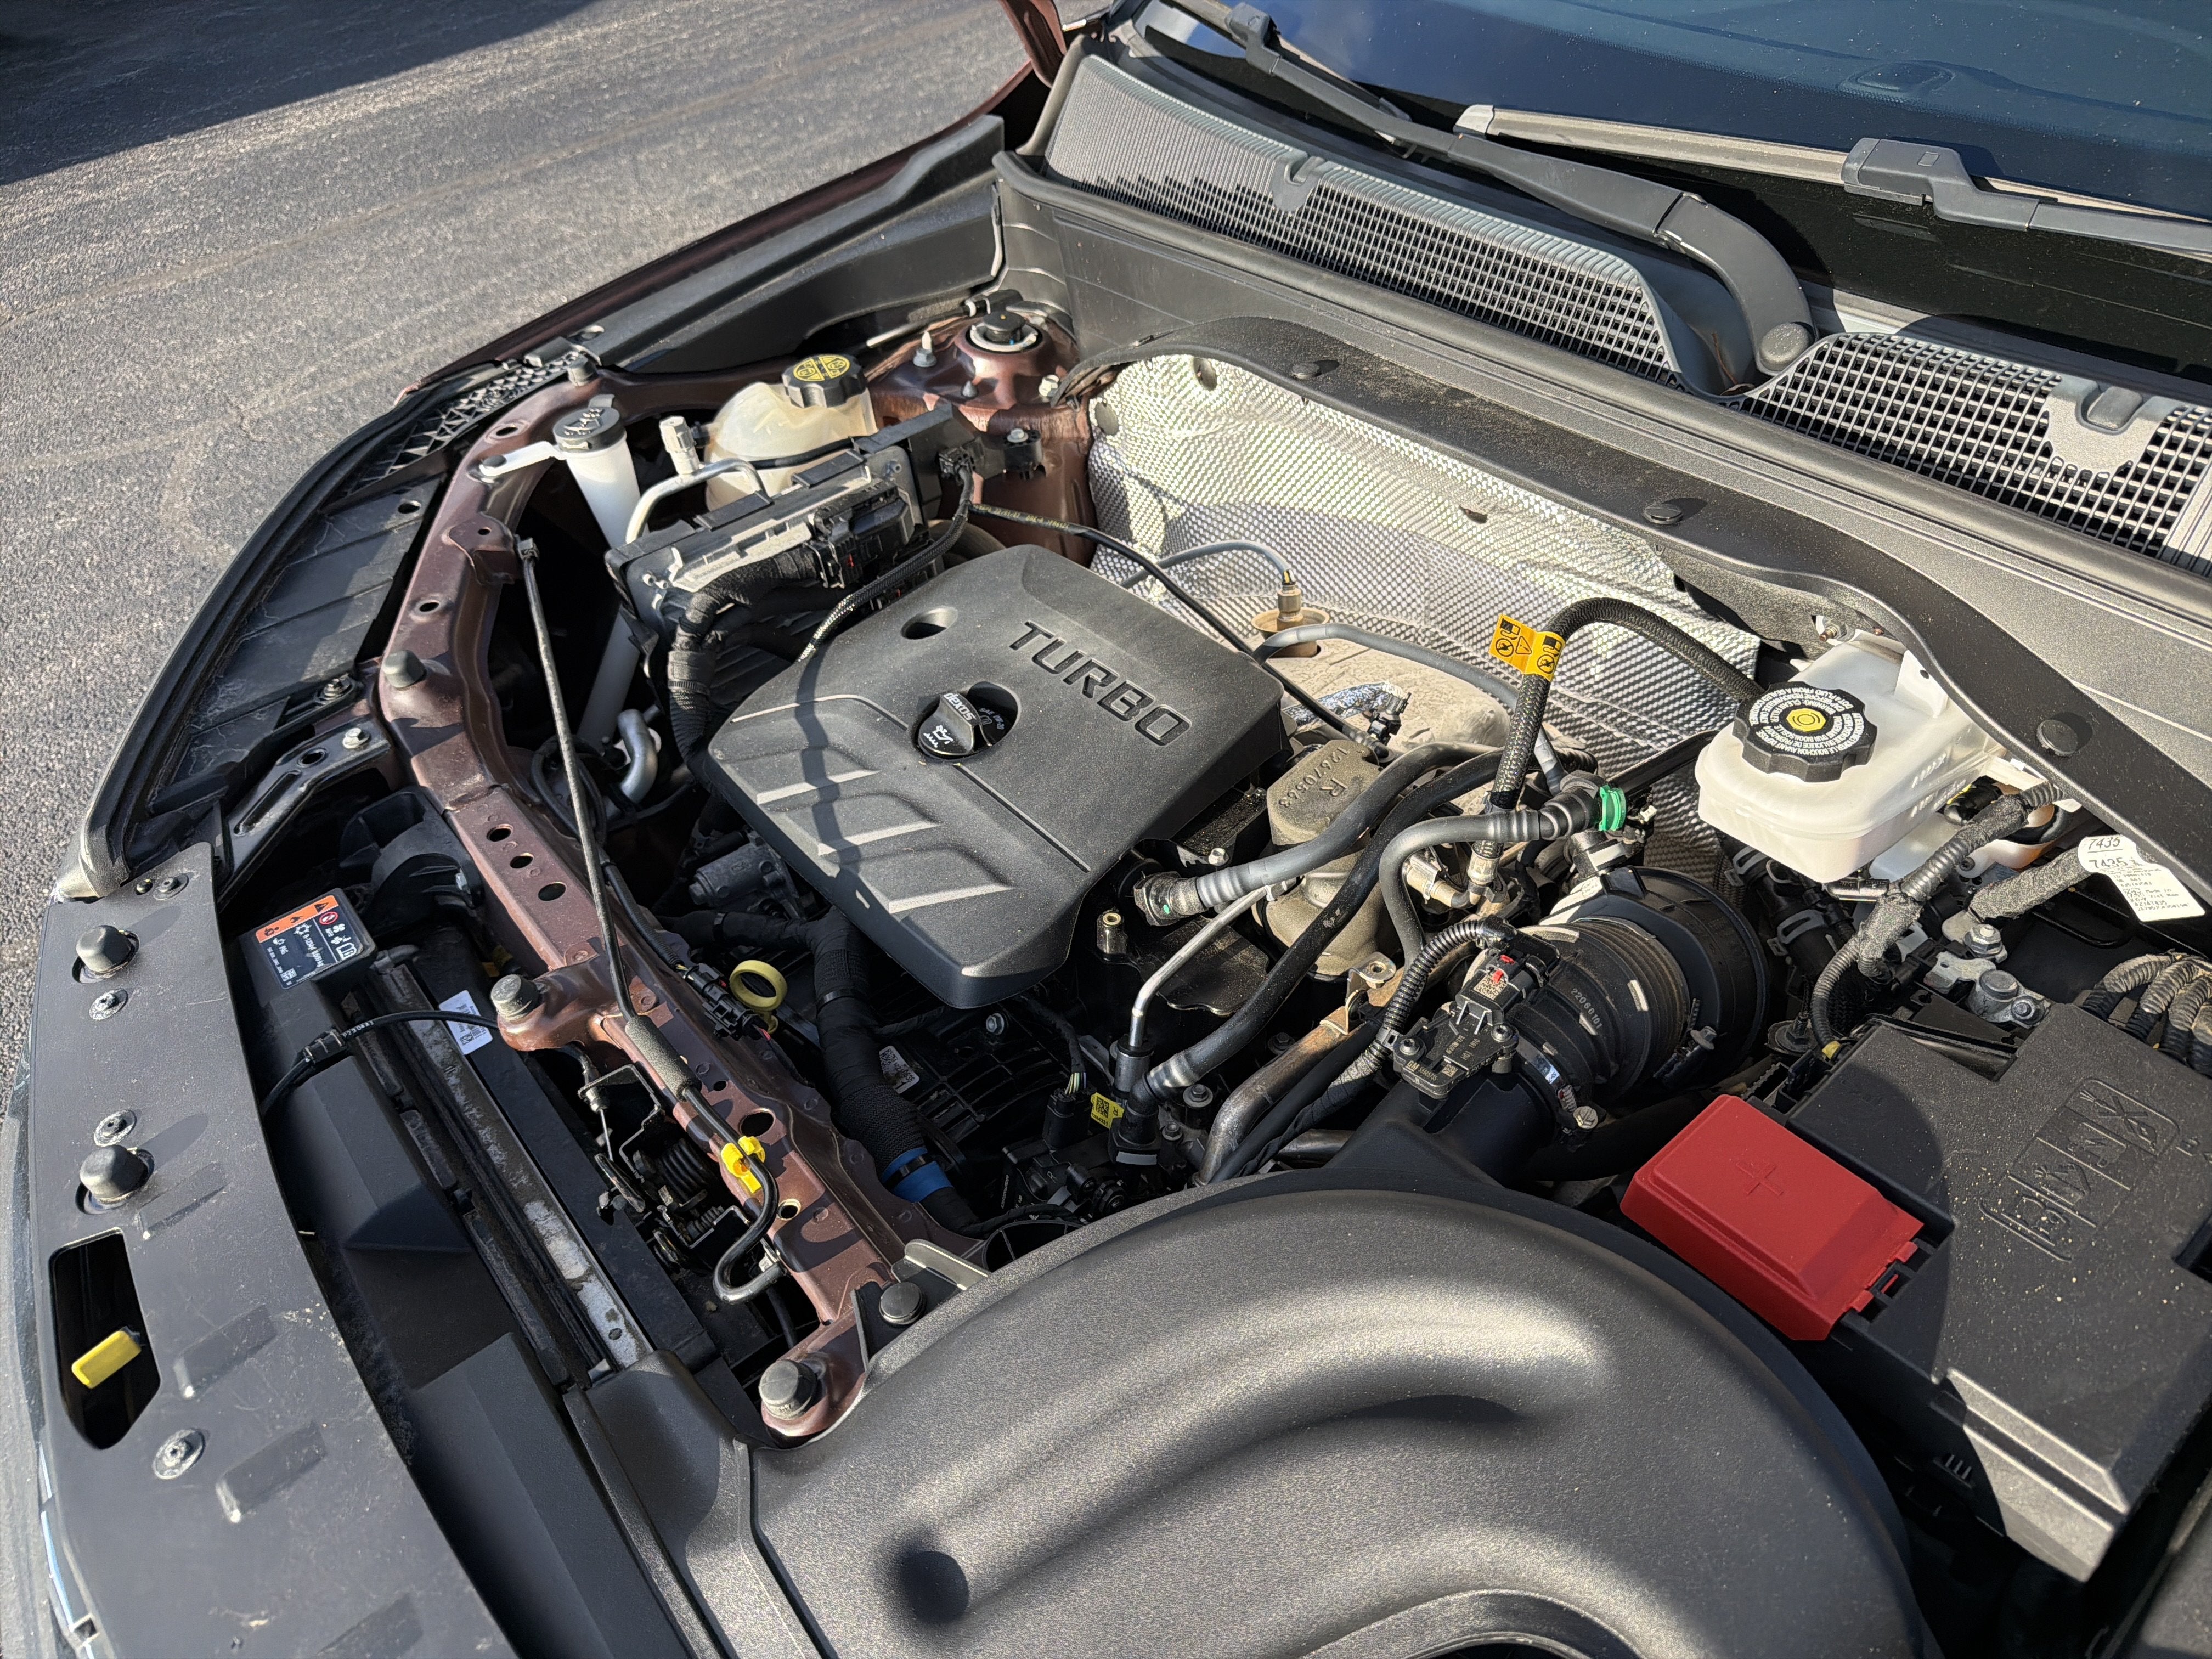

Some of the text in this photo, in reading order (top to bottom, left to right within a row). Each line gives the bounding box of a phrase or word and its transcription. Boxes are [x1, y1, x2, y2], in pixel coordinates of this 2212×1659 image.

[1009, 620, 1193, 746] TURBO
[1762, 689, 1786, 701] SEALED
[1804, 693, 1833, 704] BEFORE
[1815, 690, 1836, 699] FLUID
[943, 692, 977, 721] dexos
[1778, 699, 1801, 709] CLEAN
[1775, 743, 1797, 753] AVANT
[1797, 747, 1829, 755] BOUCHON
[1319, 777, 1348, 797] R
[2088, 836, 2122, 850] 7435
[2089, 857, 2128, 869] 7435
[279, 945, 289, 955] PAG
[1571, 988, 1602, 1029] 22060101
[1407, 1060, 1420, 1070] GM
